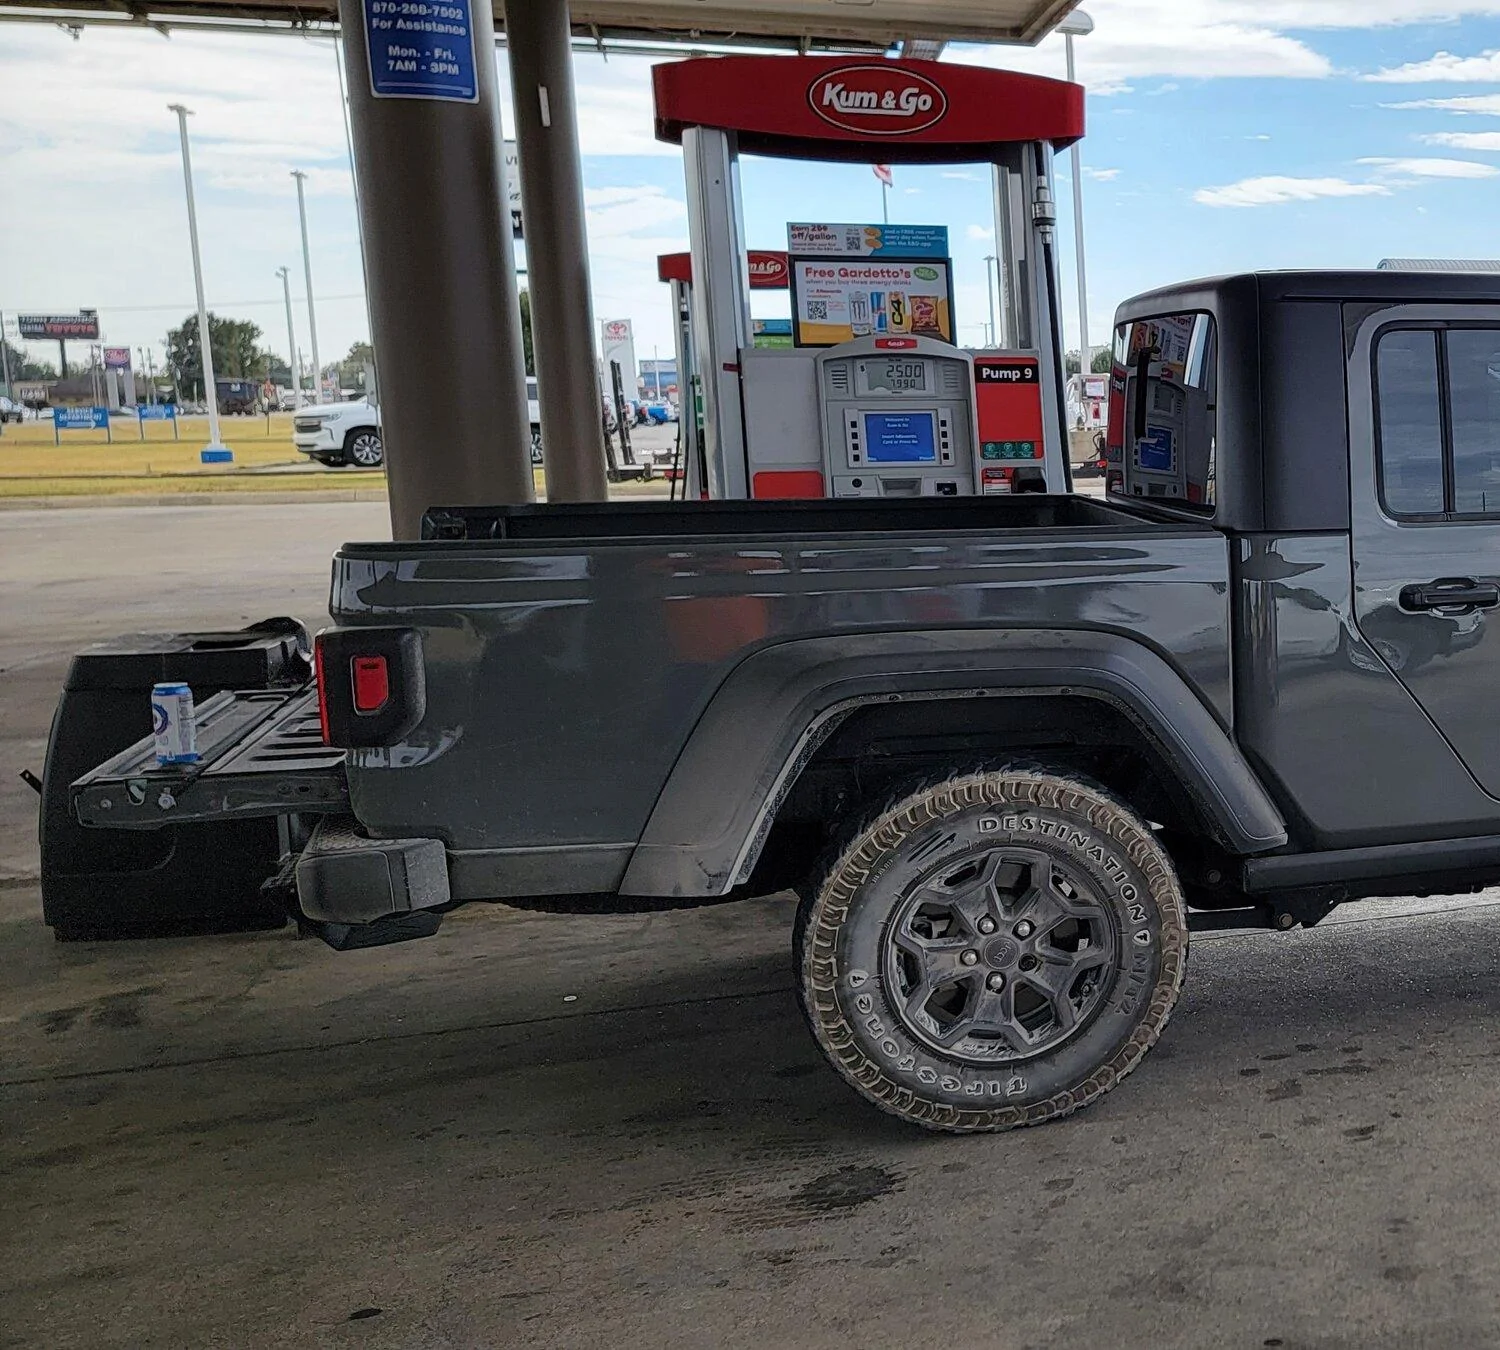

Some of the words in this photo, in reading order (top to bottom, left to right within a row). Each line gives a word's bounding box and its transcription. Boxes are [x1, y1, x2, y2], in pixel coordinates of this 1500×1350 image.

[372, 18, 393, 30] For
[396, 18, 467, 36] Assistance
[388, 45, 421, 58] Mon.
[387, 60, 417, 72] 7AM
[430, 62, 460, 75] 3PM
[822, 82, 878, 110] Kum
[881, 90, 896, 109] &
[899, 87, 932, 115] Go
[791, 232, 837, 241] off/gallon
[767, 260, 781, 273] Go
[805, 267, 835, 277] Free
[838, 267, 911, 279] Gardetto's
[982, 367, 1021, 381] Pump
[1024, 367, 1033, 379] 9
[978, 815, 1147, 924] DESTINATION
[856, 993, 1029, 1096] Firestone
